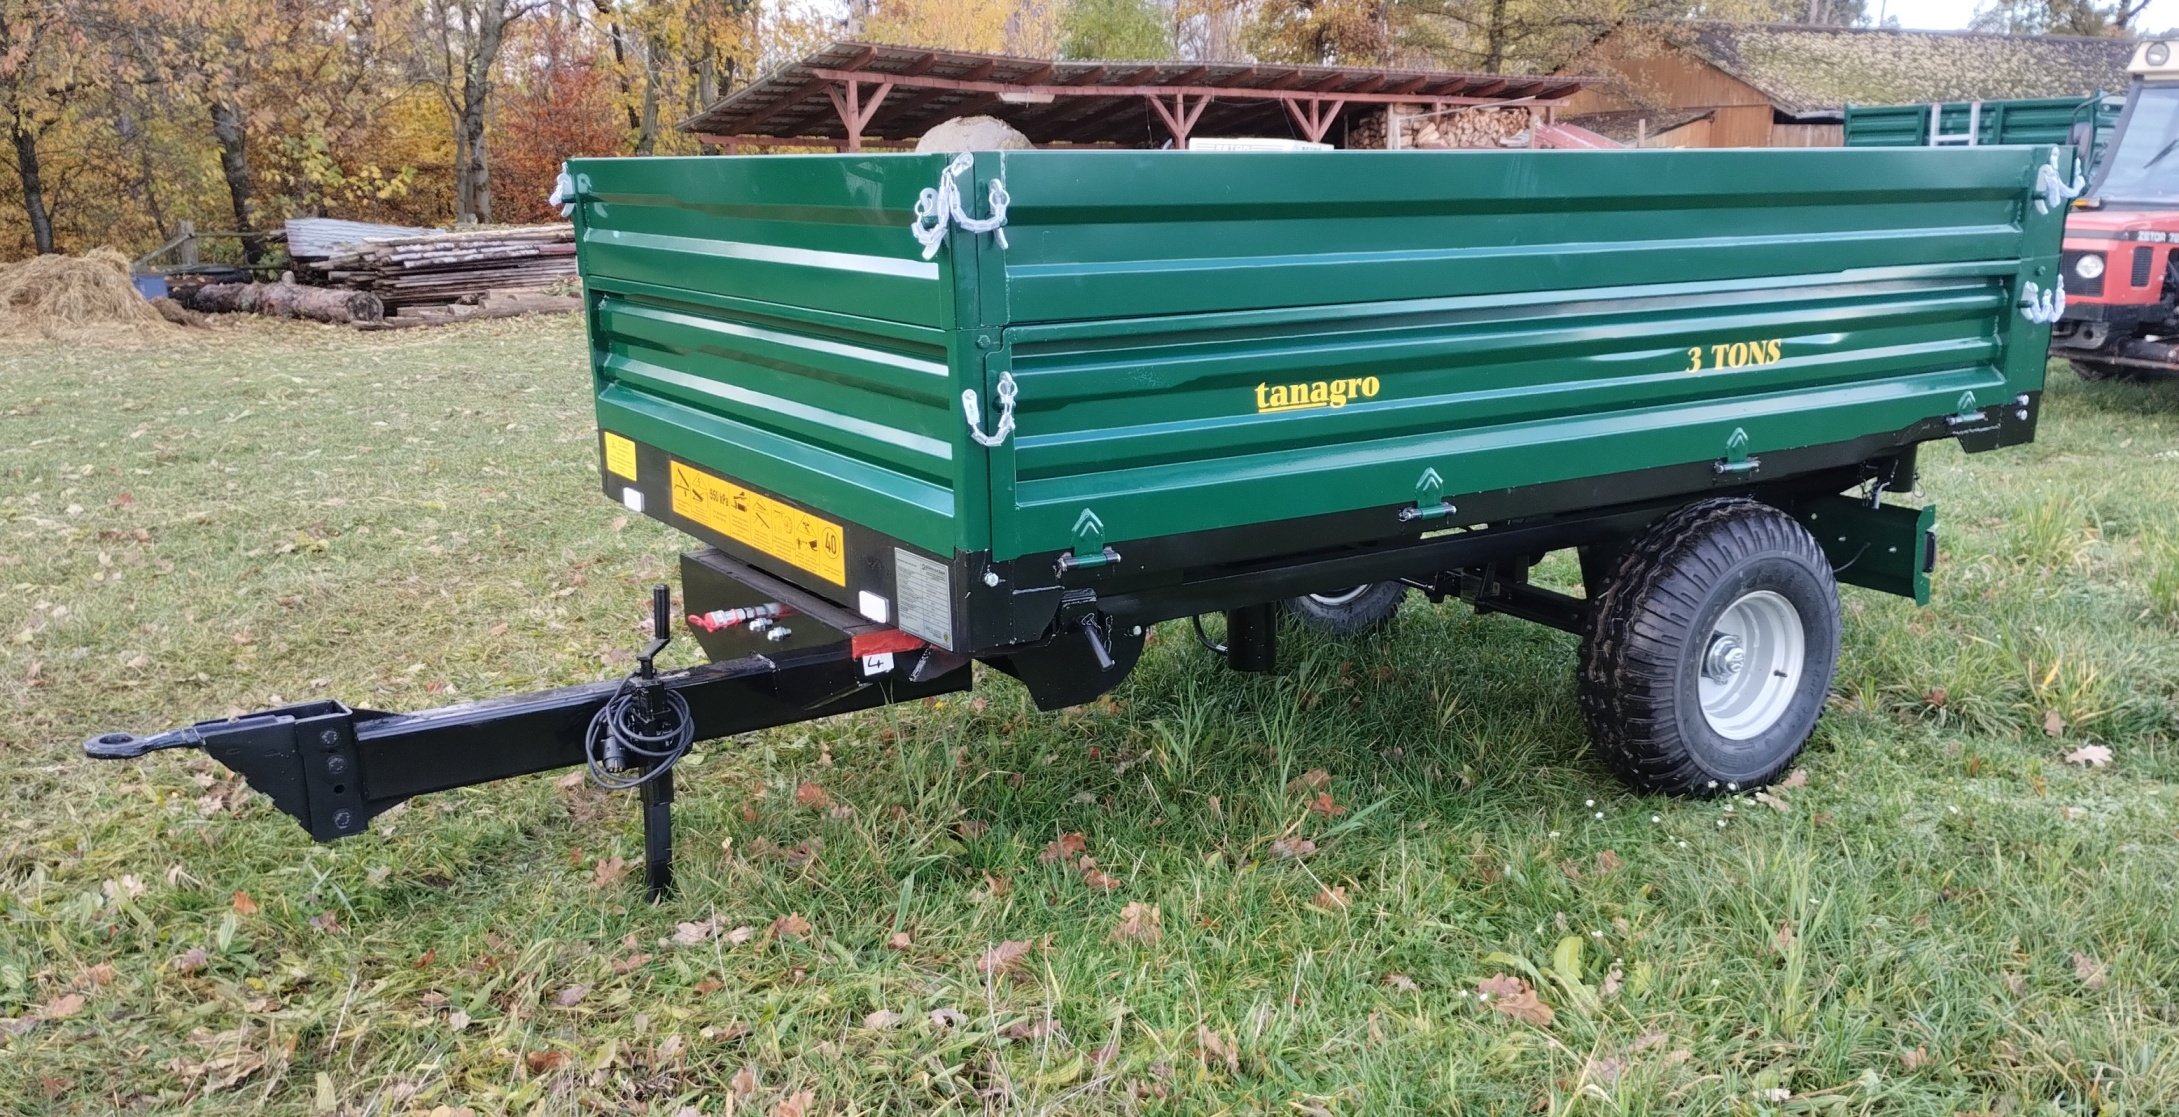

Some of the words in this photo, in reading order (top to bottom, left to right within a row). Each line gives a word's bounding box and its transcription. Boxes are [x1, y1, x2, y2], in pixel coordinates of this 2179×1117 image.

[1686, 346, 1702, 373] 3
[1711, 338, 1782, 370] TONS
[1254, 376, 1380, 413] tanagro
[825, 532, 837, 555] 40
[867, 656, 884, 669] 4
